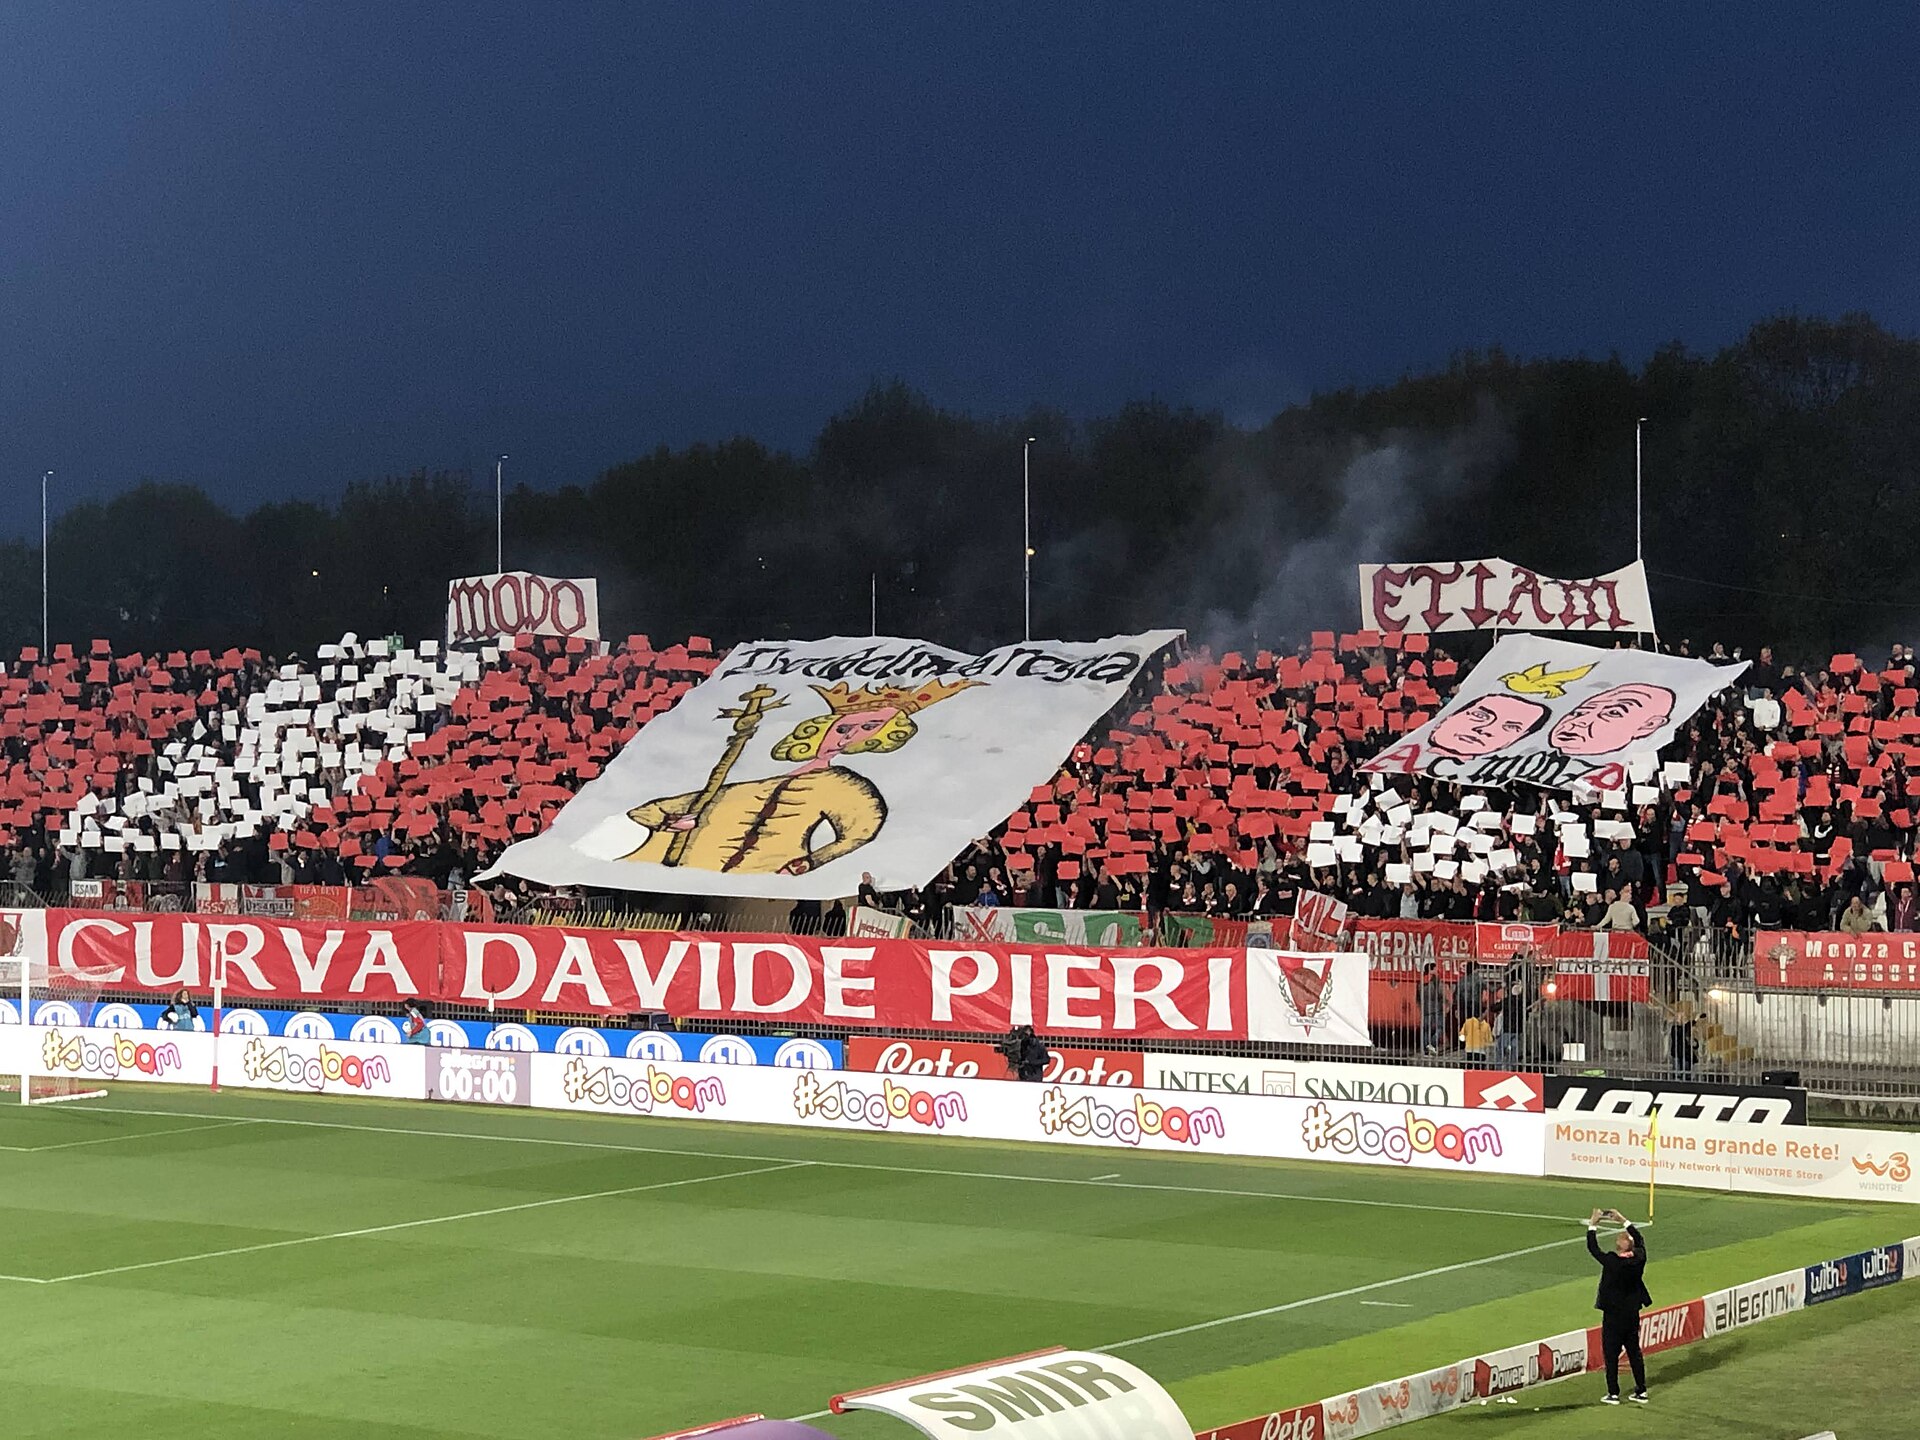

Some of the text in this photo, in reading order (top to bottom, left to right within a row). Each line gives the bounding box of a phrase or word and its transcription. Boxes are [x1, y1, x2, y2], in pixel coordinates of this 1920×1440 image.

[58, 918, 419, 995] CURVA
[1557, 959, 1647, 974] LIMBIAE
[1806, 940, 1889, 959] Monza
[460, 931, 877, 1019] DAVIDE
[928, 949, 1233, 1031] PIERI
[439, 1066, 517, 1103] 00:00
[1555, 1123, 1621, 1146] Monza
[1660, 1135, 1696, 1151] una
[1704, 1137, 1777, 1157] grande
[1785, 1140, 1840, 1161] Rete!
[1571, 1152, 1602, 1165] Scopri
[1605, 1155, 1615, 1165] la
[1618, 1156, 1636, 1168] Top
[1639, 1158, 1676, 1171] Quality
[1679, 1161, 1721, 1174] Network
[1743, 1166, 1793, 1178] WINDTRE
[1795, 1171, 1824, 1181] Store
[1858, 1182, 1904, 1193] WINDTRE
[1639, 1306, 1690, 1349] NERVIT
[1490, 1364, 1525, 1395] Power
[1553, 1349, 1585, 1375] Power
[908, 1359, 1138, 1432] SMIR
